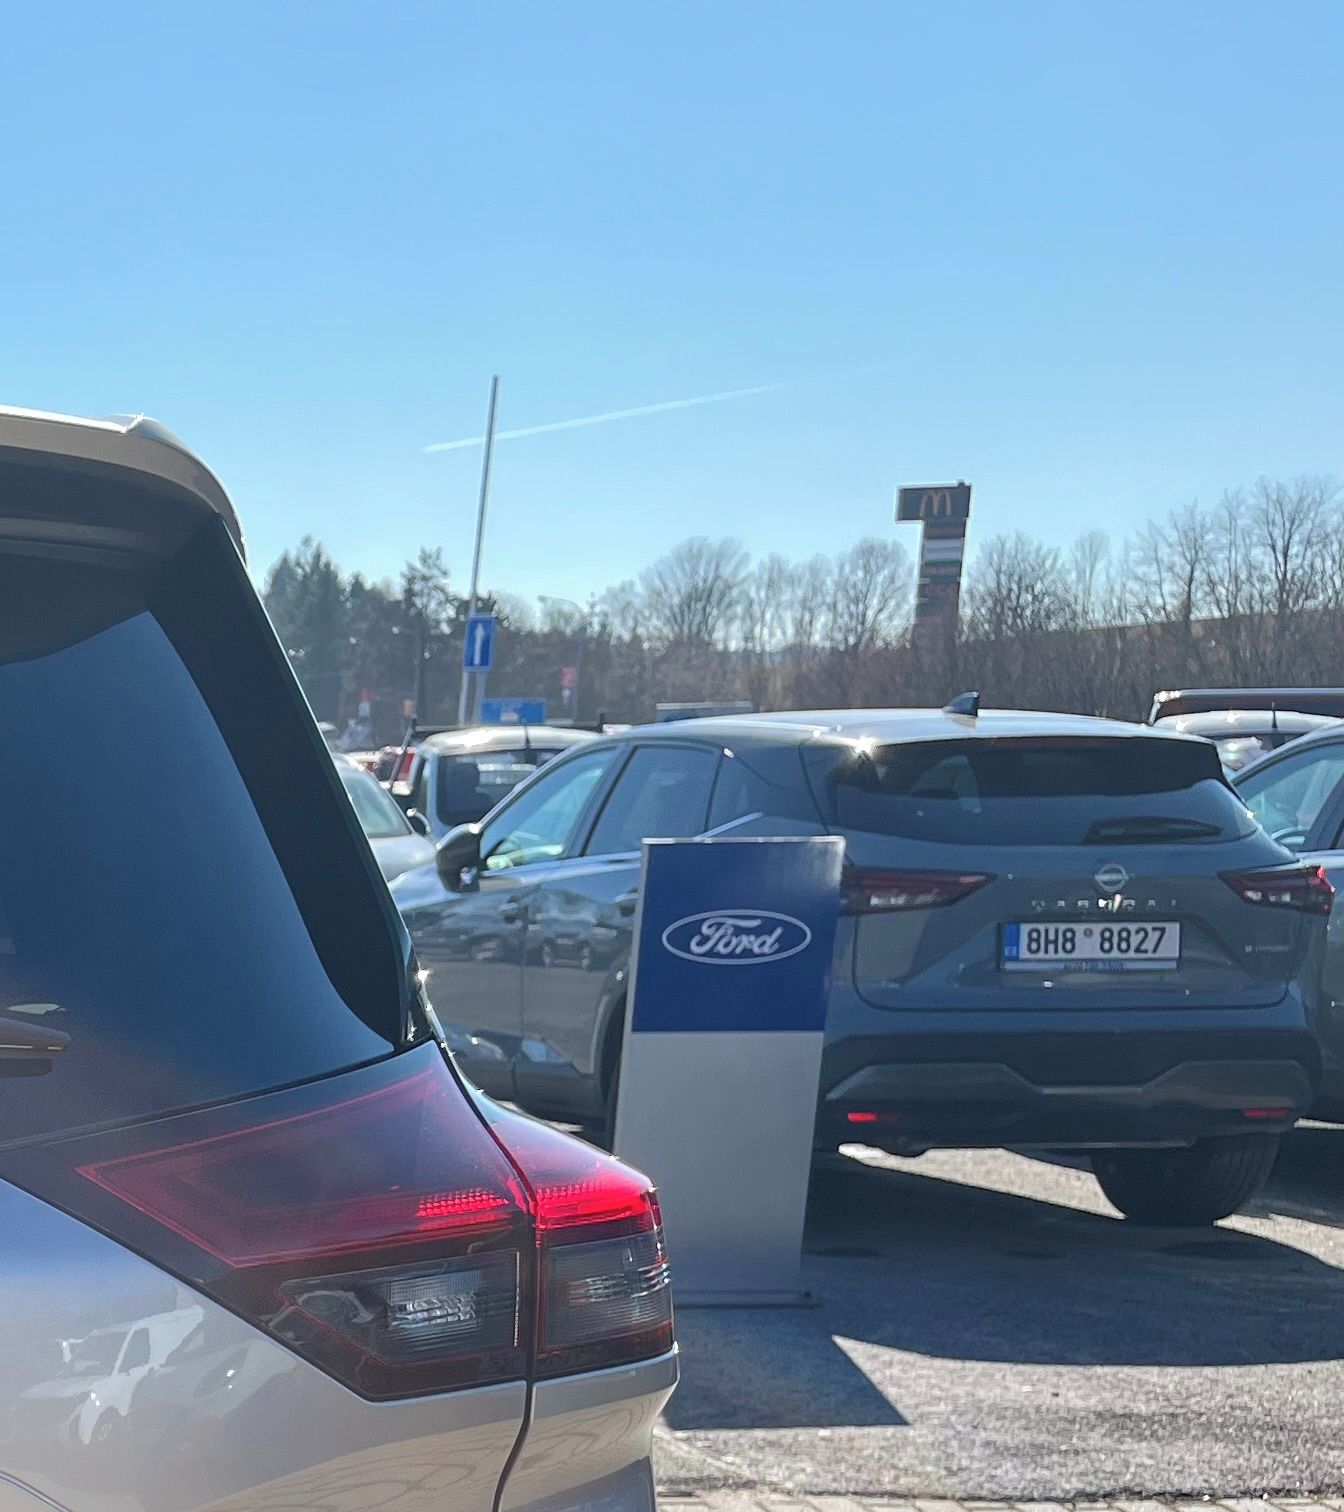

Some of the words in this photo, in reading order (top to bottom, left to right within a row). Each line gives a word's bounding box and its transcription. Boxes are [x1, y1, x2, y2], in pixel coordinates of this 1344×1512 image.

[690, 917, 784, 955] Ford
[1027, 927, 1076, 955] 8H8
[1099, 927, 1167, 955] 8827
